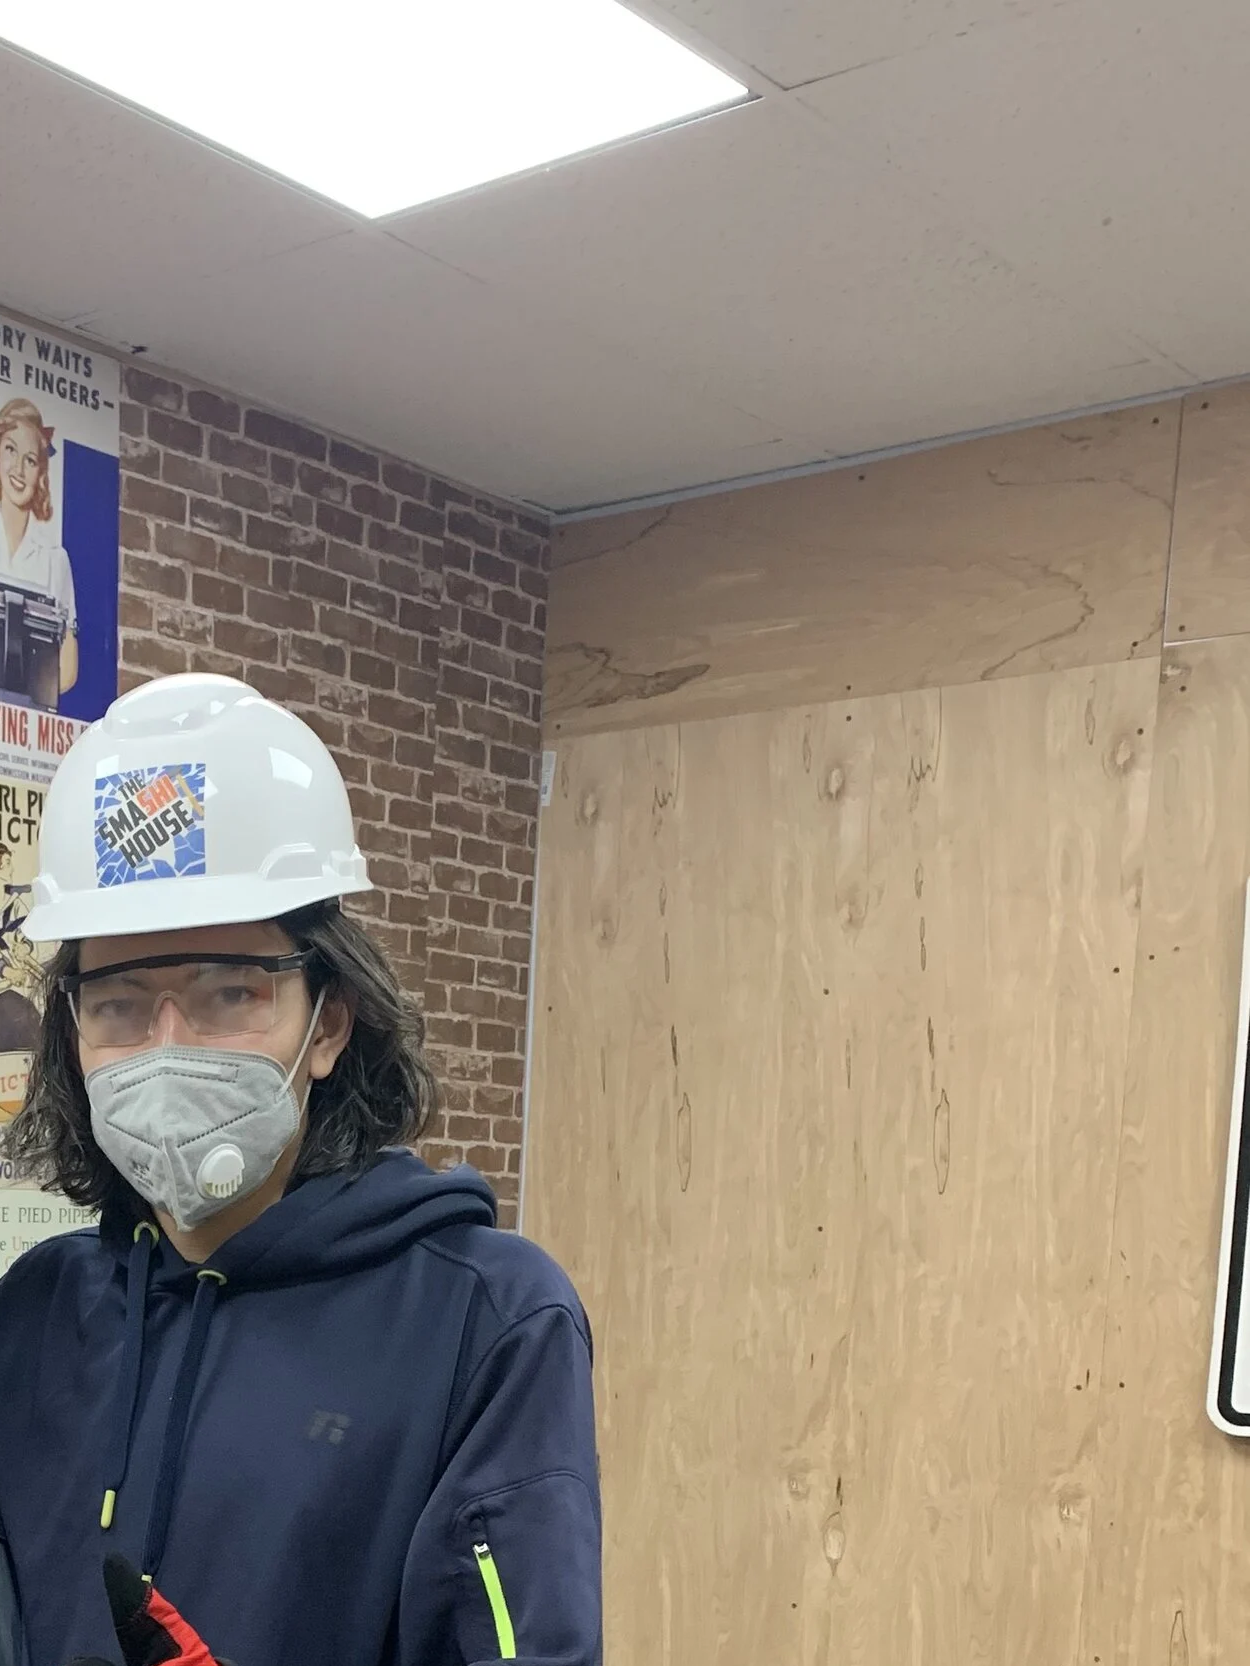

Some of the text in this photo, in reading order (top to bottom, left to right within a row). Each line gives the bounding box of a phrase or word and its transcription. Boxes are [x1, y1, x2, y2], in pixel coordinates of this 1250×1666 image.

[35, 337, 93, 378] WAITS
[38, 715, 75, 756] MISS
[118, 774, 146, 801] THE
[119, 800, 195, 869] HOUSE
[18, 1207, 52, 1223] PIED
[58, 1208, 100, 1225] PIPER
